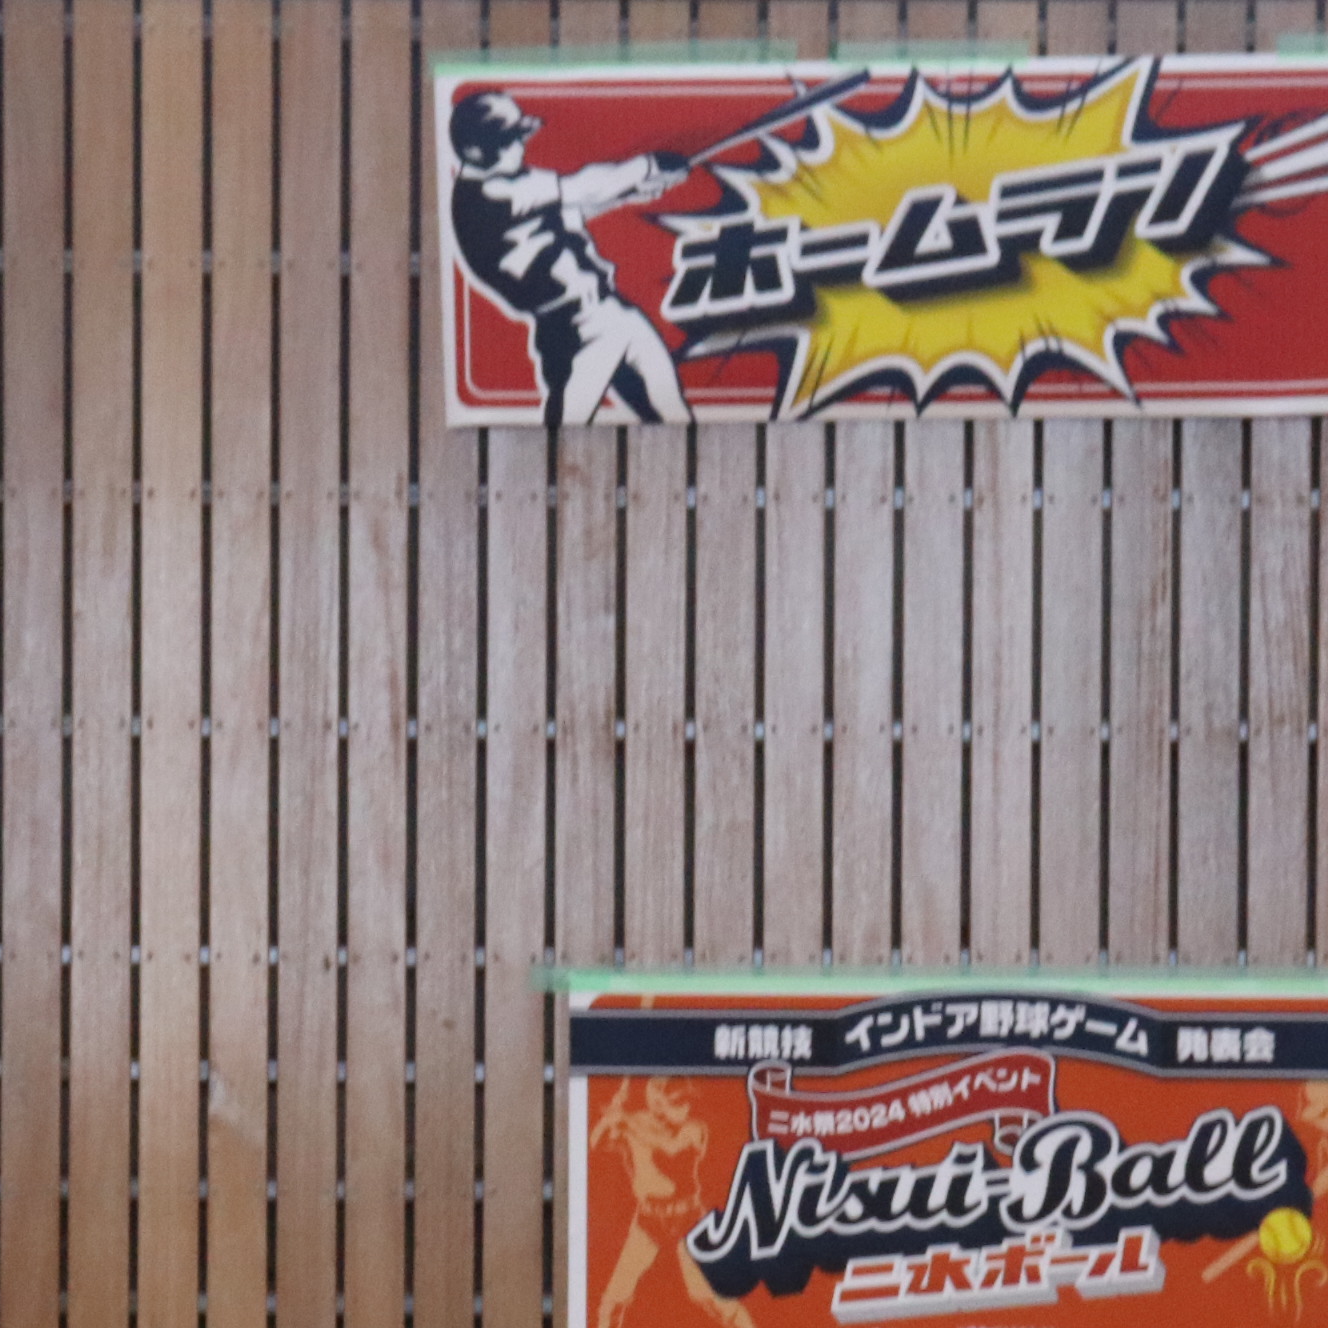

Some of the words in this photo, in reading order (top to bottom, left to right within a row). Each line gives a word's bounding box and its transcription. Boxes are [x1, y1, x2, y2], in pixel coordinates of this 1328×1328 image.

[662, 123, 1244, 322] ホームラン
[845, 999, 1148, 1056] インドア野球ゲーム
[768, 1099, 905, 1137] 二水祭2024
[908, 1066, 1041, 1116] 特別イベント
[686, 1105, 1288, 1262] Nisui-Ball
[834, 1228, 1160, 1318] 二水ボール
